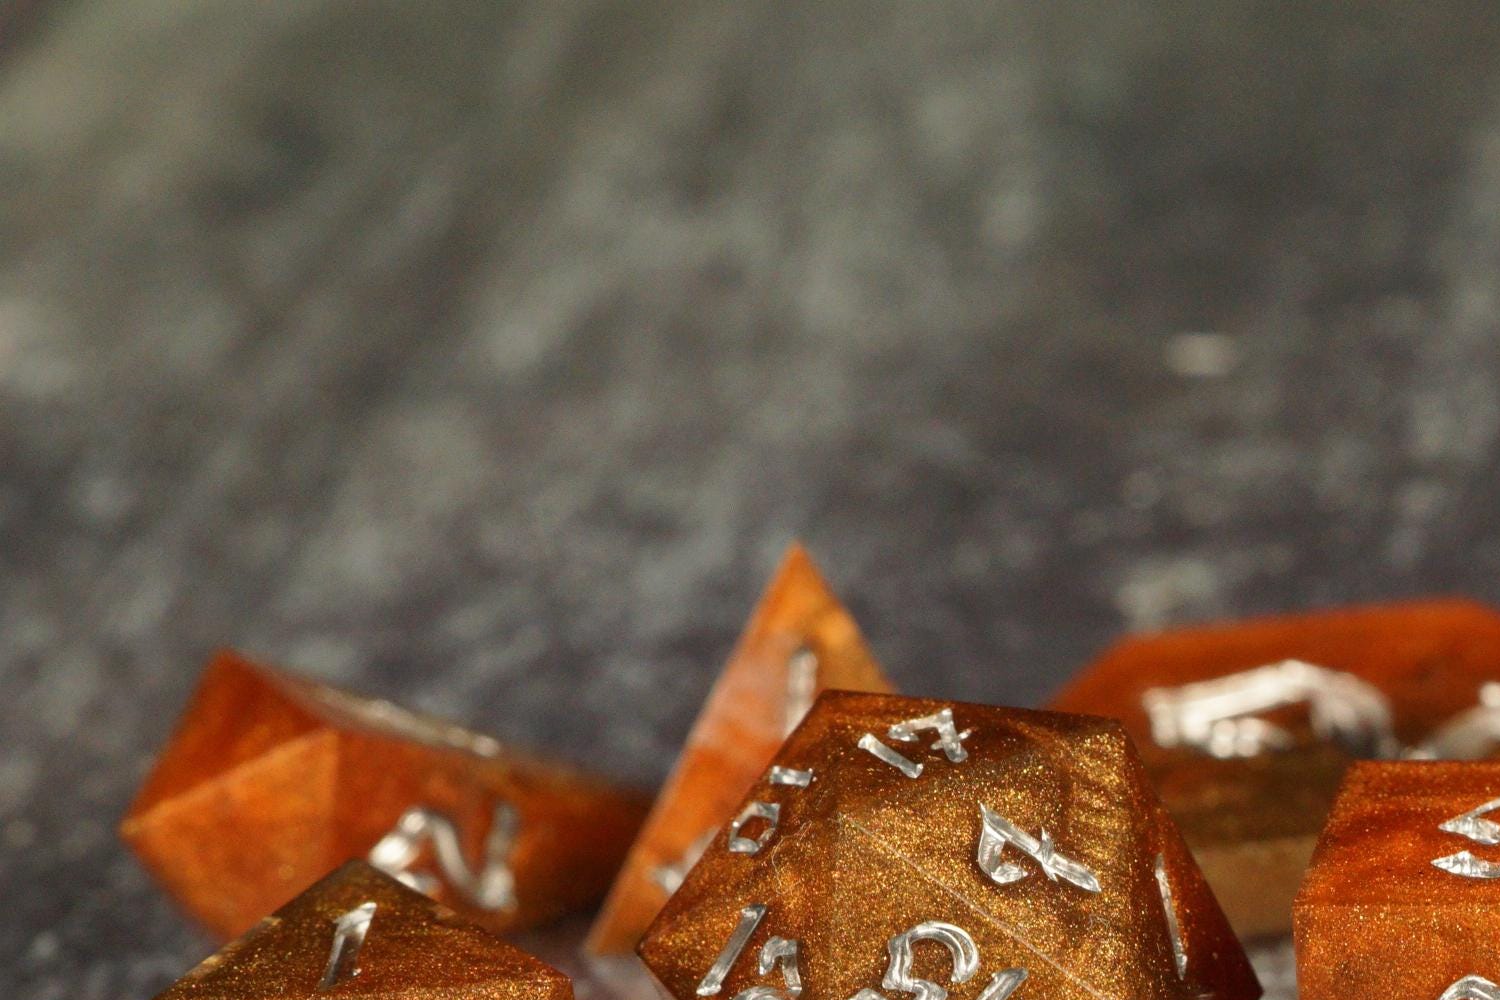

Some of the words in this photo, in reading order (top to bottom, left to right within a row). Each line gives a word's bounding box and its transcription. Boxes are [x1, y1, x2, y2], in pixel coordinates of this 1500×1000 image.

[858, 708, 975, 778] 17
[729, 765, 815, 856] 10
[977, 803, 1101, 893] 7
[318, 902, 377, 991] 1
